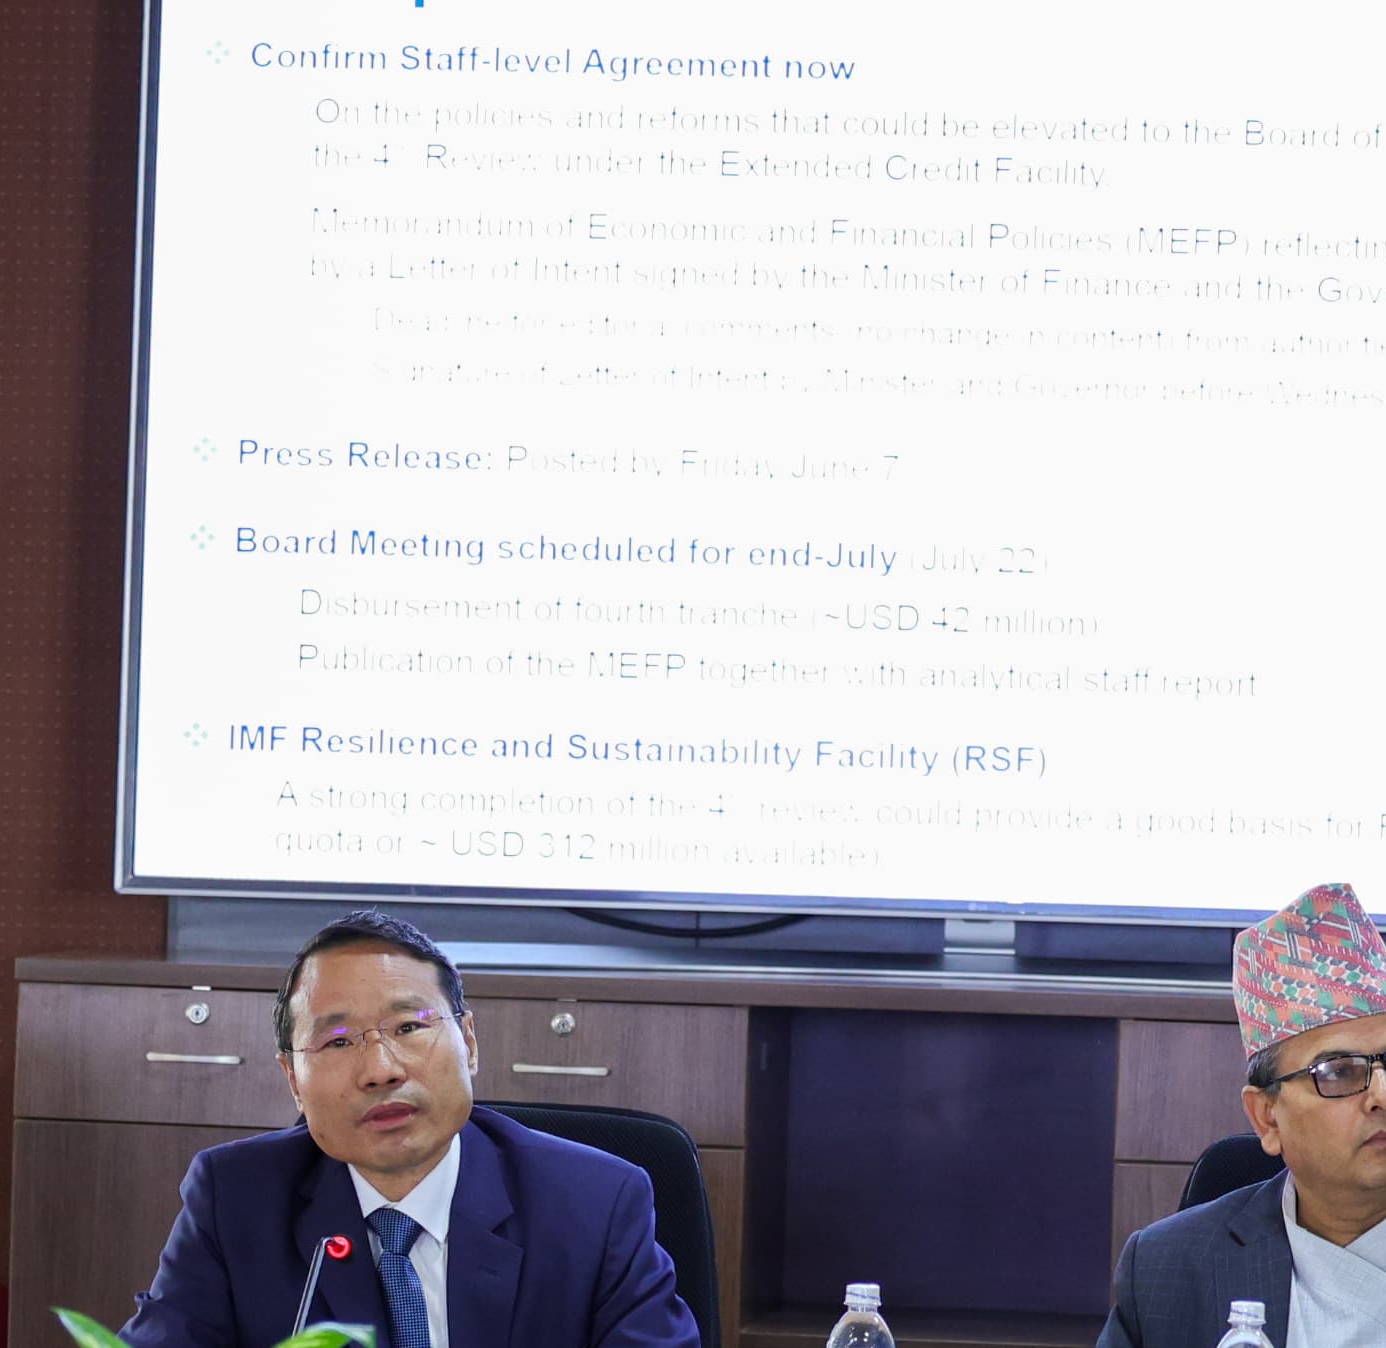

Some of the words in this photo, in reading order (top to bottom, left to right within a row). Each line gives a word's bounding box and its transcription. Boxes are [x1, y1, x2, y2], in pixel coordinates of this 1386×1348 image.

[251, 41, 386, 70] Confirm
[400, 44, 570, 74] Staff-level
[582, 48, 772, 82] Agreement
[785, 60, 855, 80] now
[315, 98, 359, 124] On
[374, 99, 421, 125] the
[435, 101, 553, 134] policies
[566, 104, 624, 129] and
[638, 106, 759, 133] reforms
[771, 107, 831, 135] that
[843, 111, 928, 137] could
[942, 112, 980, 138] be
[992, 113, 1128, 142] elevated
[1141, 119, 1172, 143] to
[1182, 117, 1231, 144] the
[1244, 117, 1339, 148] Board
[1353, 123, 1383, 149] of
[309, 142, 361, 167] the
[555, 148, 642, 175] under
[659, 149, 707, 176] the
[719, 150, 872, 180] Extended
[885, 152, 981, 184] Credit
[310, 207, 533, 238] Memorandum
[546, 213, 576, 237] of
[588, 213, 746, 242] Economic
[758, 219, 817, 244] and
[829, 216, 974, 248] Financial
[989, 223, 1112, 251] Policies
[1126, 224, 1249, 256] (MEFP)
[358, 261, 375, 277] a
[389, 253, 475, 280] Letter
[491, 257, 523, 280] of
[534, 256, 621, 284] Intent
[632, 260, 738, 293] signed
[800, 263, 849, 288] the
[863, 263, 987, 293] Minister
[1001, 269, 1029, 293] of
[1043, 265, 1171, 296] Finance
[1184, 274, 1241, 299] and
[1253, 274, 1304, 301] the
[238, 439, 333, 468] Press
[348, 441, 491, 471] Release:
[507, 445, 617, 473] Posted
[790, 454, 869, 479] June
[883, 454, 901, 480] 7
[236, 526, 336, 556] Board
[350, 529, 484, 566] Meeting
[498, 534, 676, 563] scheduled
[689, 538, 736, 565] for
[749, 541, 897, 576] end-July
[300, 587, 524, 621] Disbursement
[534, 595, 565, 621] of
[575, 596, 664, 624] fourth
[677, 599, 797, 628] tranche
[931, 606, 971, 634] 42
[297, 644, 472, 673] Publication
[486, 648, 516, 675] of
[526, 650, 575, 677] the
[588, 648, 686, 680] MEFP
[699, 656, 827, 688] together
[919, 664, 1070, 692] analytical
[1084, 667, 1150, 693] staff
[1163, 673, 1256, 702] report
[229, 724, 288, 752] IMF
[301, 726, 478, 757] Resilience
[491, 733, 553, 759] and
[567, 733, 801, 772] Sustainability
[816, 740, 938, 776] Facility
[953, 745, 1046, 778] (RSF)
[277, 780, 300, 807] A
[310, 784, 408, 815] strong
[421, 788, 593, 818] completion
[647, 792, 695, 816] the
[877, 800, 961, 825] could
[973, 804, 1092, 832] provide
[1135, 808, 1215, 842] good
[1229, 809, 1312, 836] basis
[1325, 813, 1362, 838] for
[274, 830, 363, 857] quota
[452, 830, 524, 858] USD
[539, 833, 595, 859] 312
[609, 836, 709, 860] million
